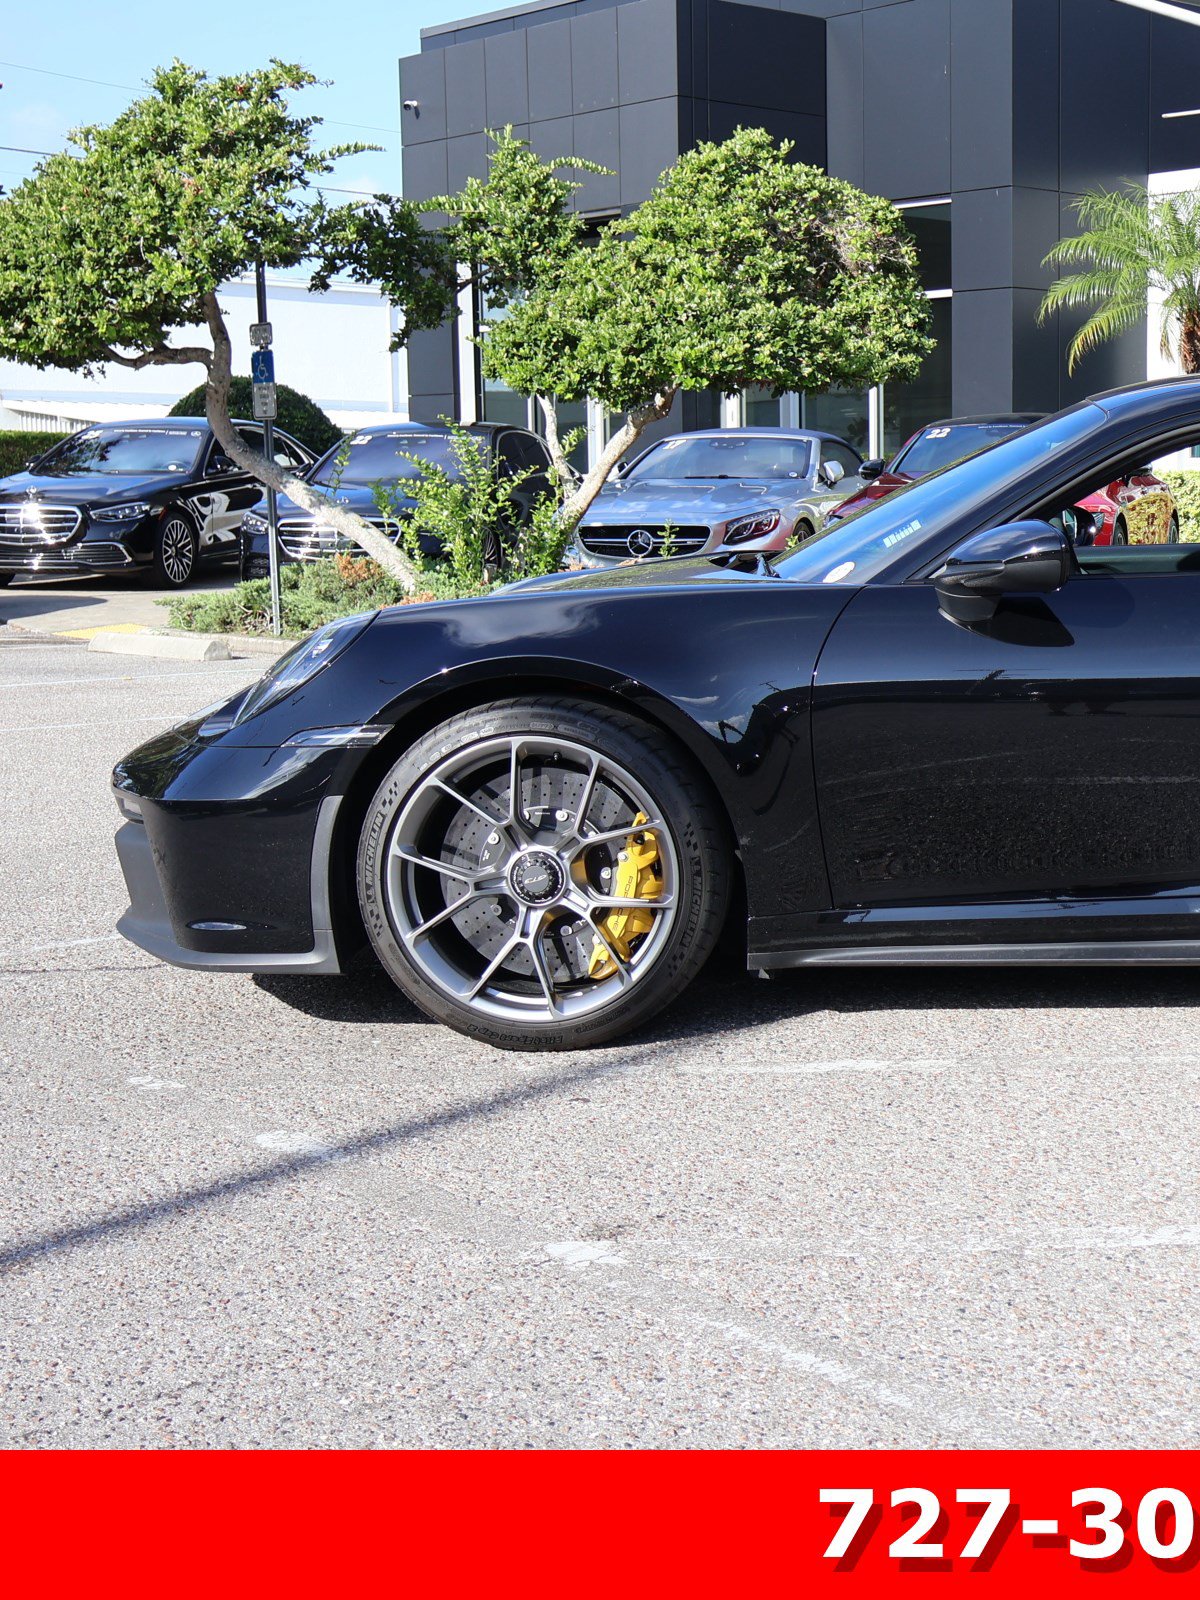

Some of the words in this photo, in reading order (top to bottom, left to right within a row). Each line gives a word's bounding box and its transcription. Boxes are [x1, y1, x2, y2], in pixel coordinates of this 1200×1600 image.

[366, 811, 385, 886] MICHELIN
[612, 875, 634, 931] PORCHE
[680, 874, 703, 947] MICHELIN
